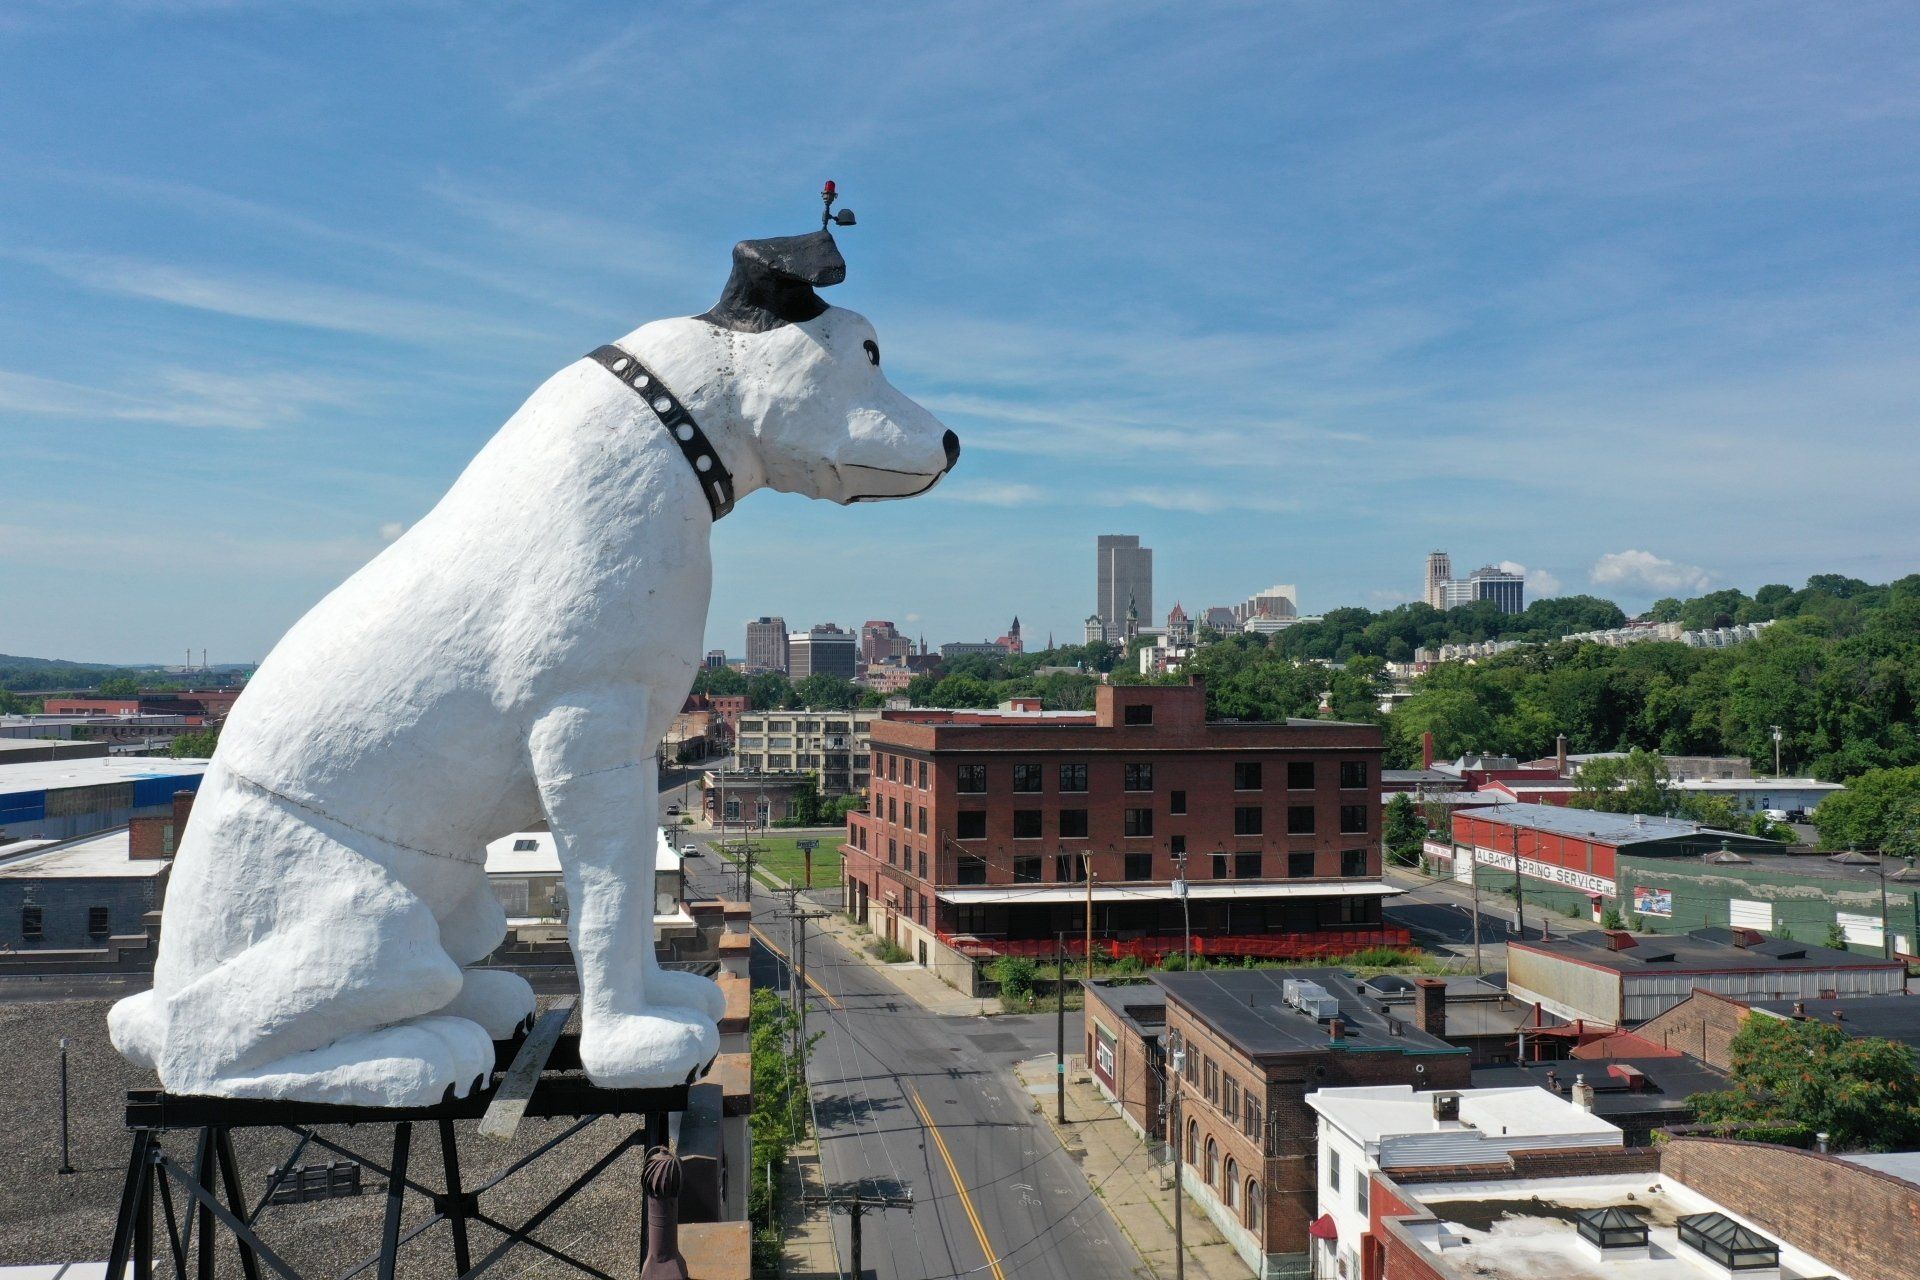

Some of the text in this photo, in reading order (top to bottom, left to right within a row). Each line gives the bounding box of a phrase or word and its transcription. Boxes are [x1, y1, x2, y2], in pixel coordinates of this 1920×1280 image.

[1476, 850, 1513, 868] ALBANY
[1517, 858, 1551, 878] SPRING
[1556, 869, 1603, 892] SERVICE
